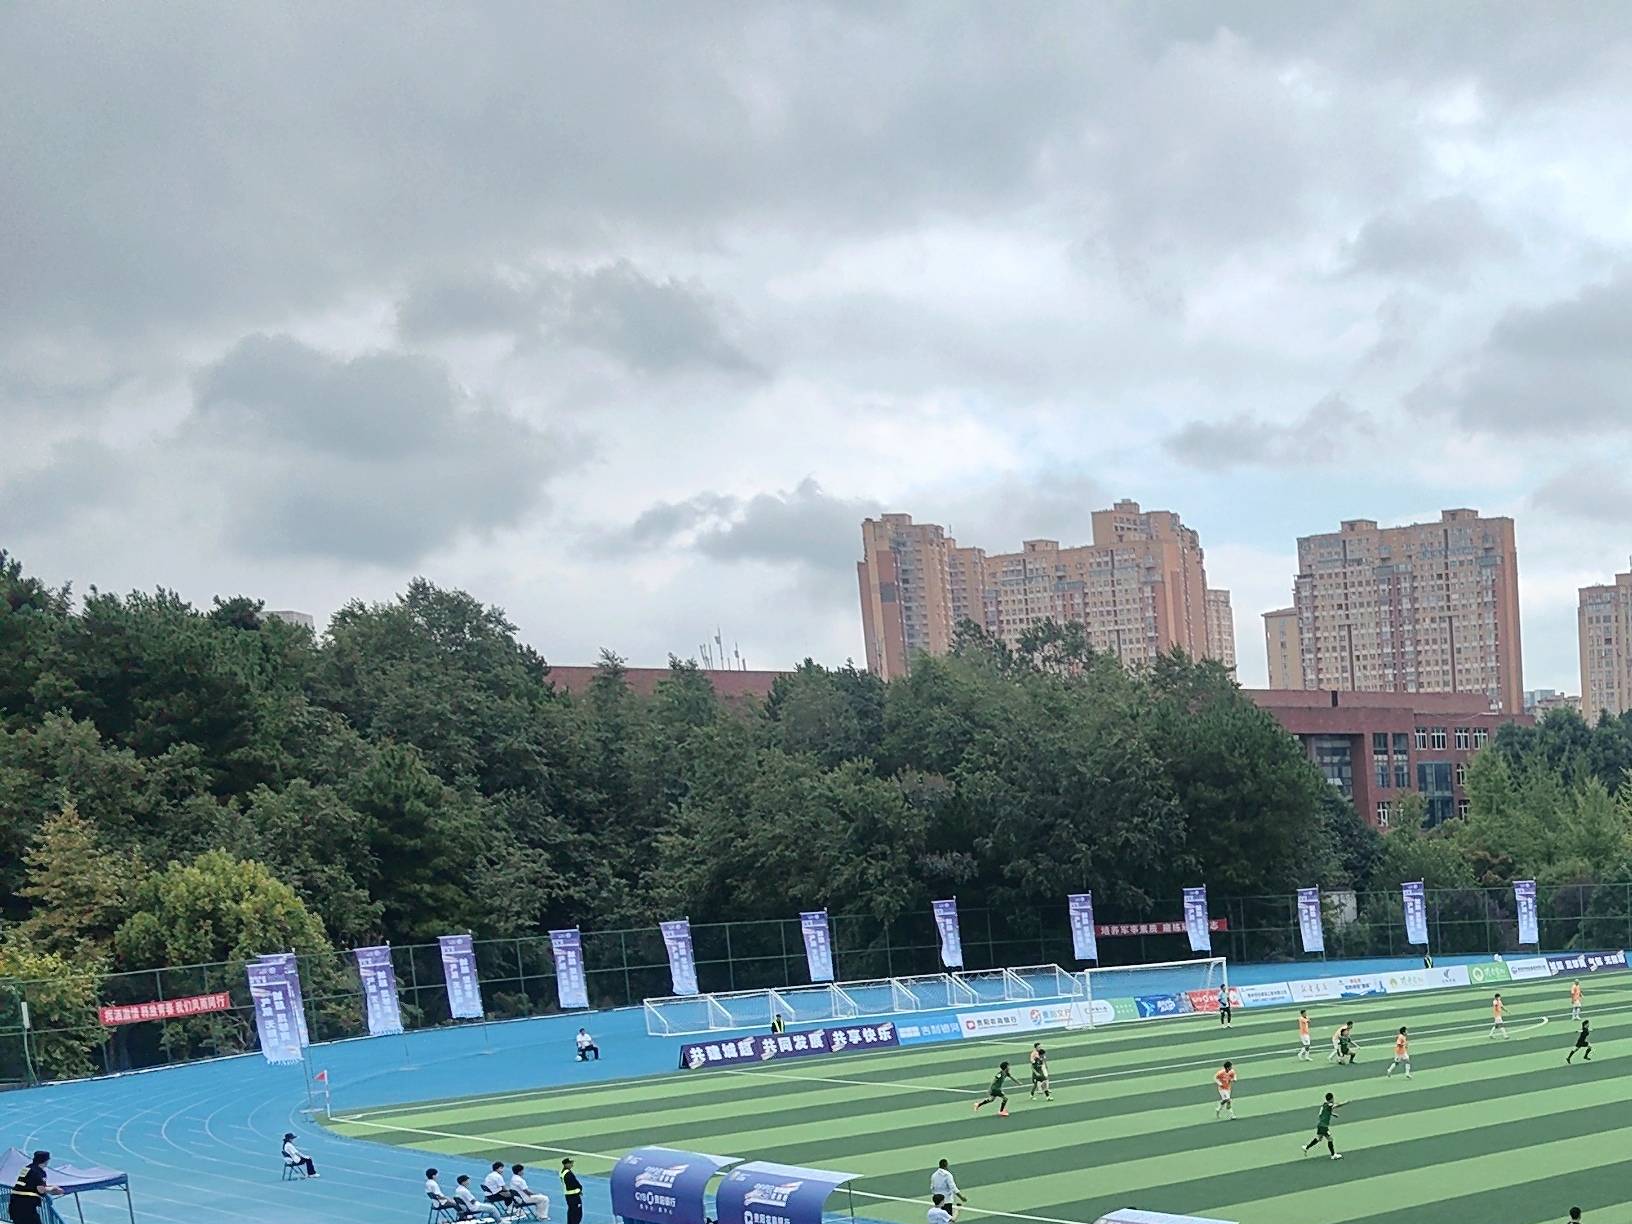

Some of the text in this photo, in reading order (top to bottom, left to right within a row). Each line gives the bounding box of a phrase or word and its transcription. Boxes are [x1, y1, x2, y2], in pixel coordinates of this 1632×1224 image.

[761, 1032, 824, 1056] 共同发展
[831, 1025, 893, 1048] 共享快乐
